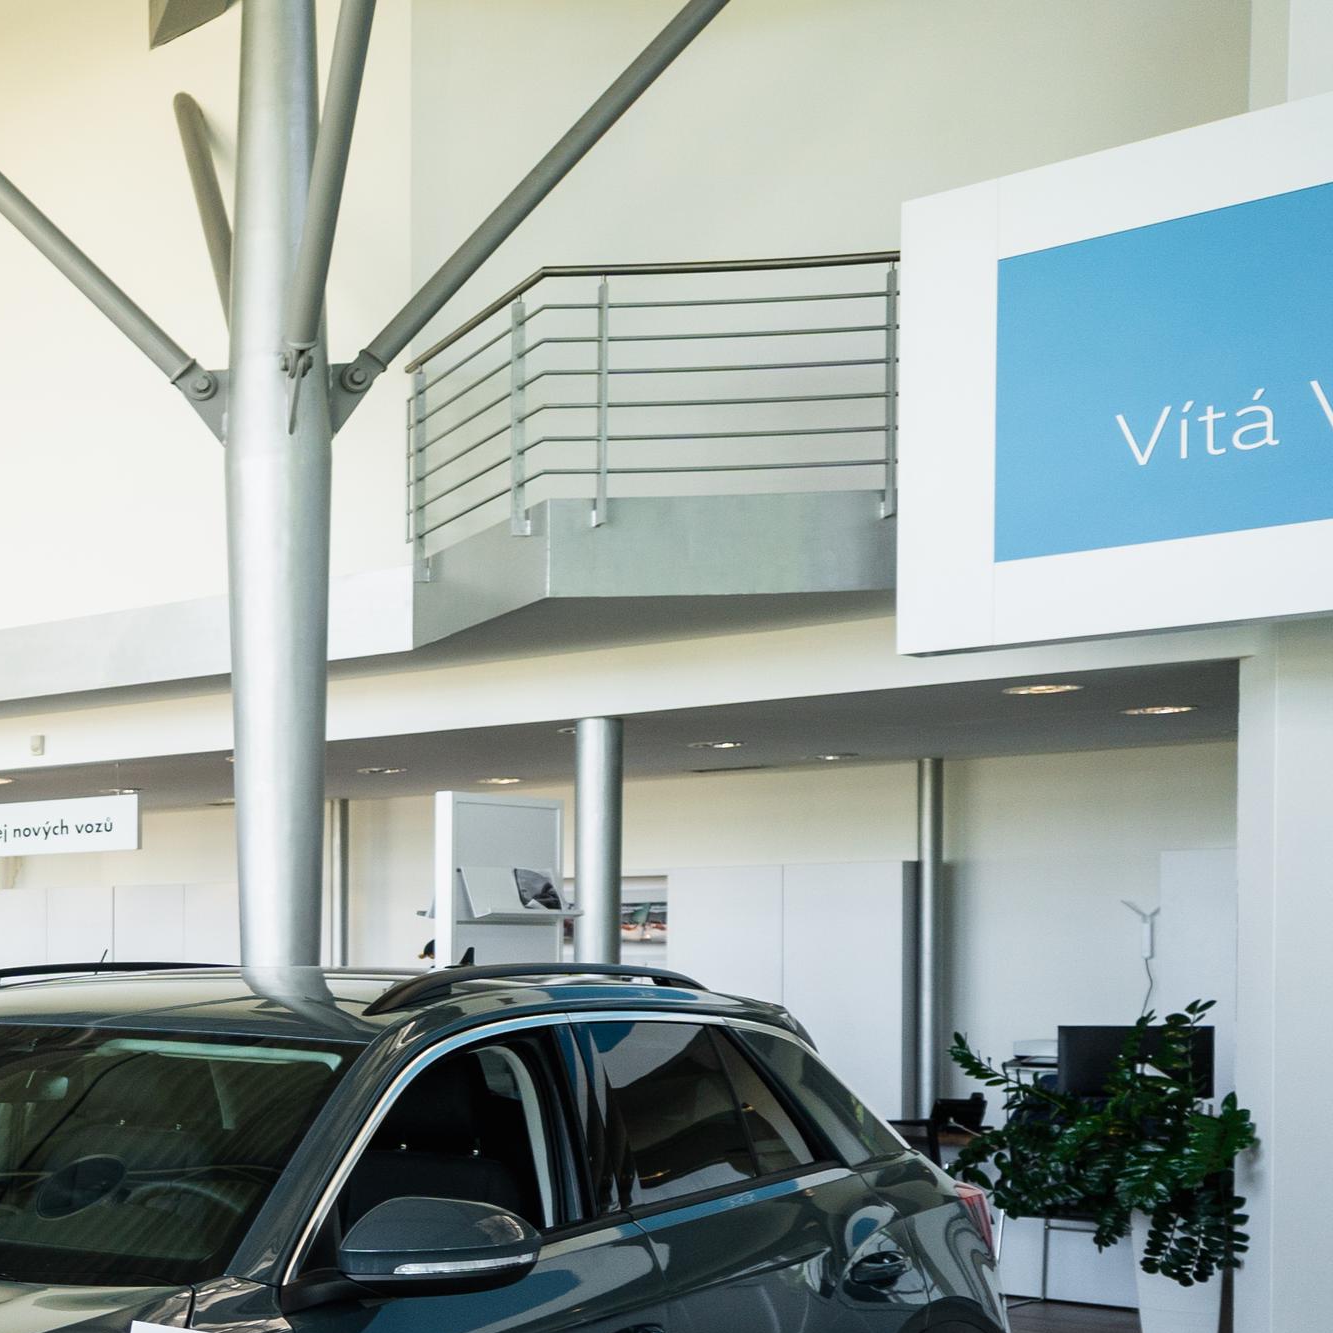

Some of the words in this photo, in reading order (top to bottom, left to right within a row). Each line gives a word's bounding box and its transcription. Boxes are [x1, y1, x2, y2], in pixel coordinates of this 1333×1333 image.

[1115, 387, 1280, 466] Vítá
[13, 818, 69, 840] nových
[75, 816, 114, 834] vozů
